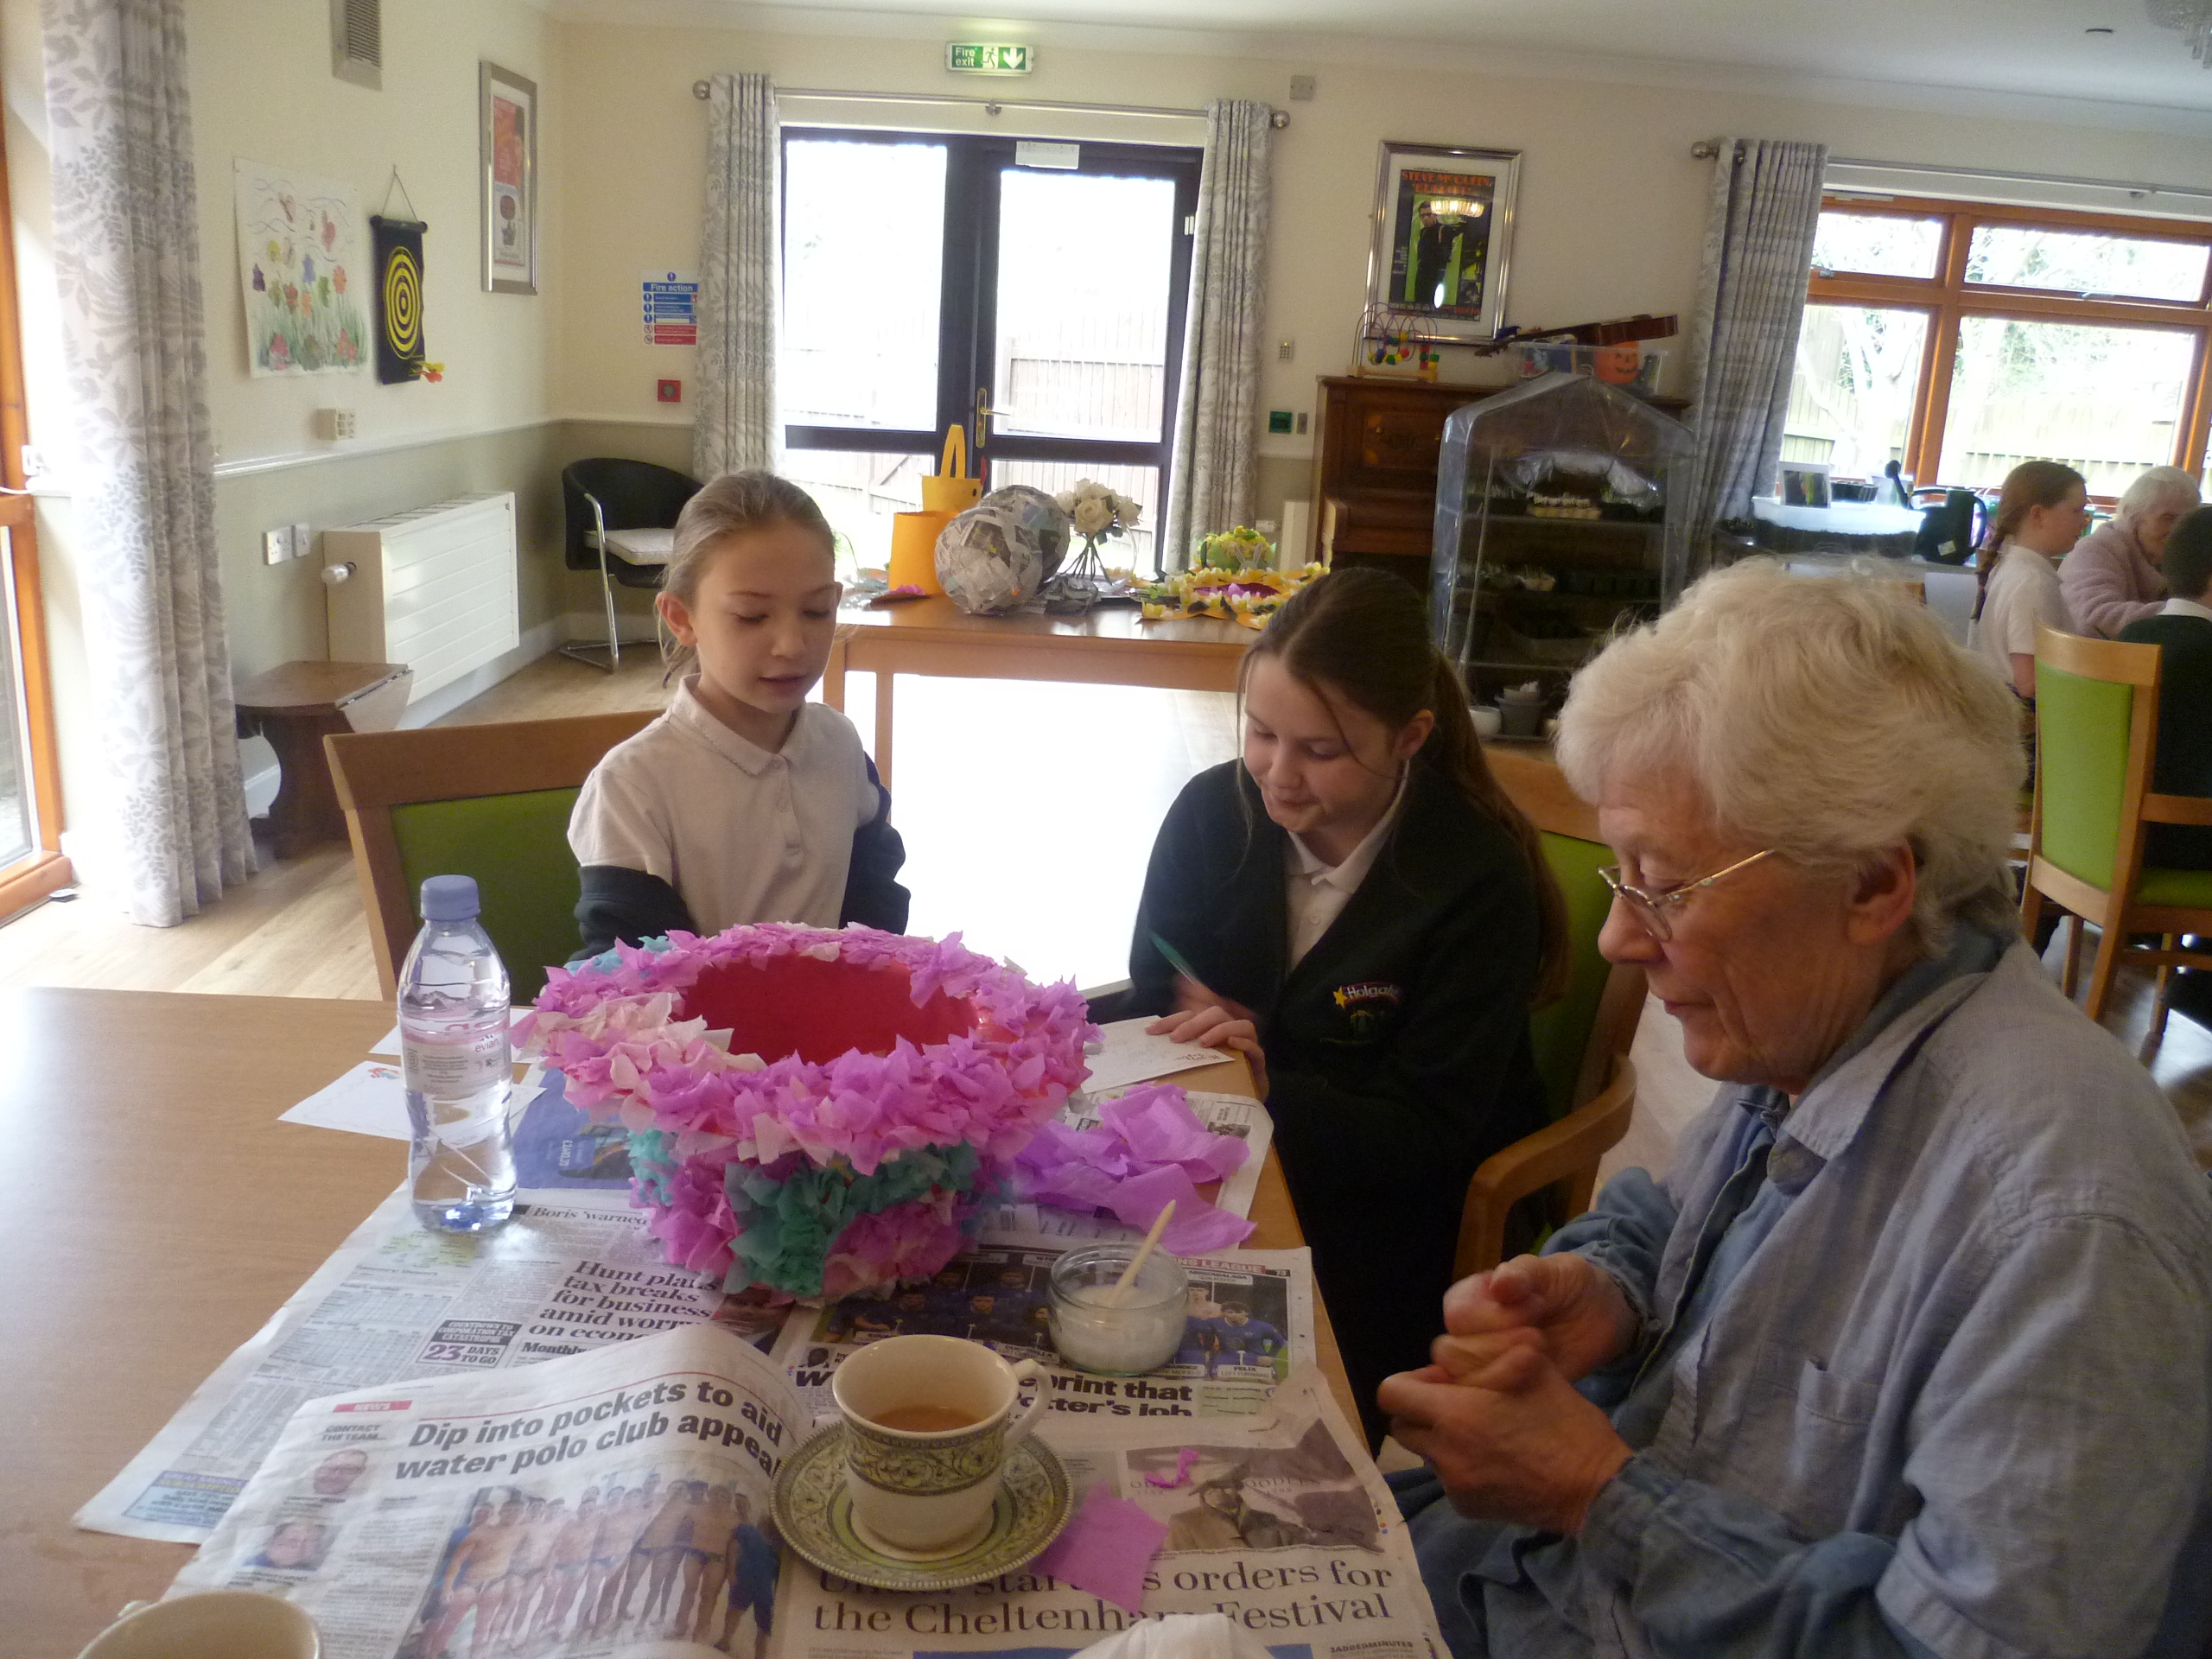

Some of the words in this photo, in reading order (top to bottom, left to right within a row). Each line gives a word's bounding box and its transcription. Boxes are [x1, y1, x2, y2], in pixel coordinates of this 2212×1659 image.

[955, 47, 976, 57] Fire
[955, 57, 975, 67] exit
[1402, 171, 1434, 182] STEVE
[651, 283, 667, 292] Fire
[1347, 984, 1399, 999] Holgat
[474, 1038, 499, 1052] evian
[533, 1206, 578, 1219] Boris
[575, 1260, 649, 1283] Hunt
[1201, 1260, 1262, 1274] LEAGUE
[563, 1274, 607, 1294] tax
[608, 1282, 700, 1304] breaks
[550, 1289, 594, 1306] for
[596, 1294, 713, 1319] business
[538, 1307, 614, 1326] amid
[618, 1317, 701, 1331] worr
[529, 1324, 565, 1338] on
[423, 1344, 466, 1362] 23
[467, 1346, 501, 1356] DAYS
[461, 1354, 480, 1363] TO
[478, 1356, 498, 1364] GO
[1124, 1381, 1192, 1402] that
[408, 1423, 469, 1452] Dip
[474, 1416, 545, 1444] into
[547, 1381, 689, 1437] pockets
[696, 1381, 734, 1408] to
[741, 1401, 783, 1448] aid
[325, 1424, 381, 1433] CONTACT
[395, 1452, 508, 1480] water
[510, 1434, 588, 1476] polo
[595, 1411, 671, 1451] club
[1173, 1560, 1319, 1591] orders
[1331, 1559, 1393, 1588] for
[814, 1600, 893, 1631] the
[905, 1598, 1195, 1635] Cheltenh
[1211, 1592, 1394, 1630] Festival
